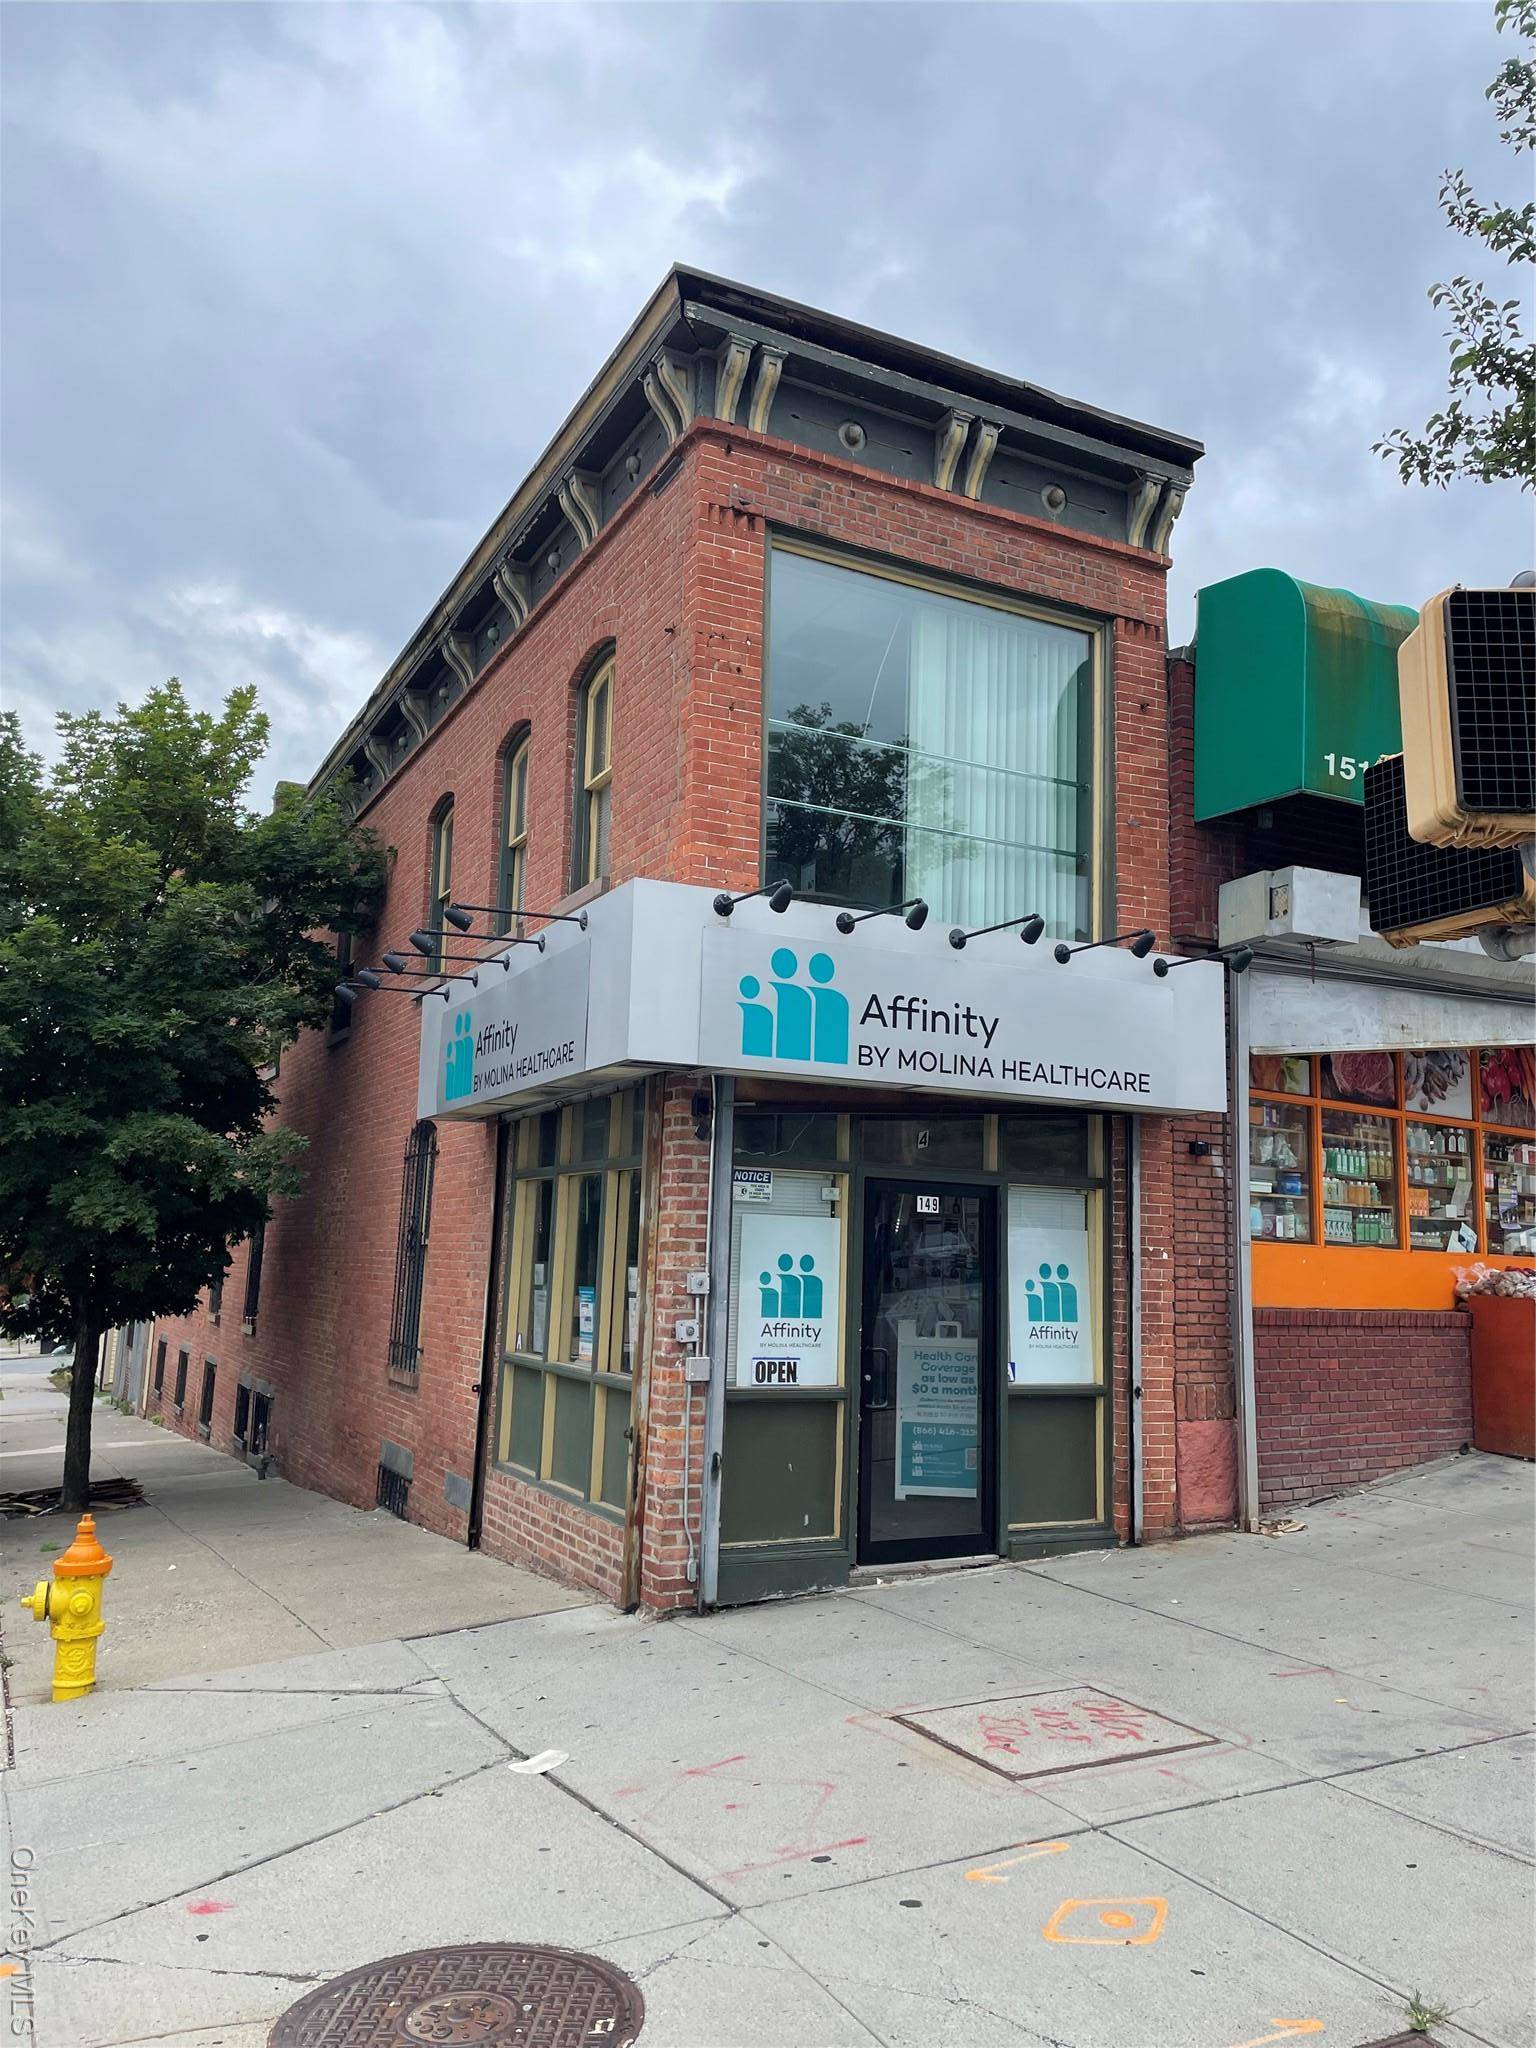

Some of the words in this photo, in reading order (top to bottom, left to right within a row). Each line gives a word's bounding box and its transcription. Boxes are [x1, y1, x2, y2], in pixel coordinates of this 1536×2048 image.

[860, 993, 999, 1048] Affinity
[475, 1020, 518, 1059] Affinity
[473, 1073, 483, 1092] BY
[484, 1062, 514, 1089] MOLINA
[516, 1040, 575, 1079] HEALTHCARE
[858, 1044, 890, 1068] BY
[898, 1049, 994, 1078] MOLINA
[1002, 1059, 1150, 1093] HEALTHCARE
[919, 1131, 928, 1146] 4
[734, 1170, 770, 1182] NOTICE
[919, 1197, 938, 1212] 149
[761, 1322, 822, 1342] Affinity
[1029, 1325, 1078, 1344] Affinity
[914, 1350, 952, 1361] Health
[955, 1352, 977, 1361] Car
[755, 1360, 797, 1383] OPEN
[921, 1362, 975, 1375] Coverage
[922, 1375, 935, 1383] as
[938, 1373, 958, 1383] low
[961, 1376, 975, 1384] as
[912, 1382, 928, 1394] $0
